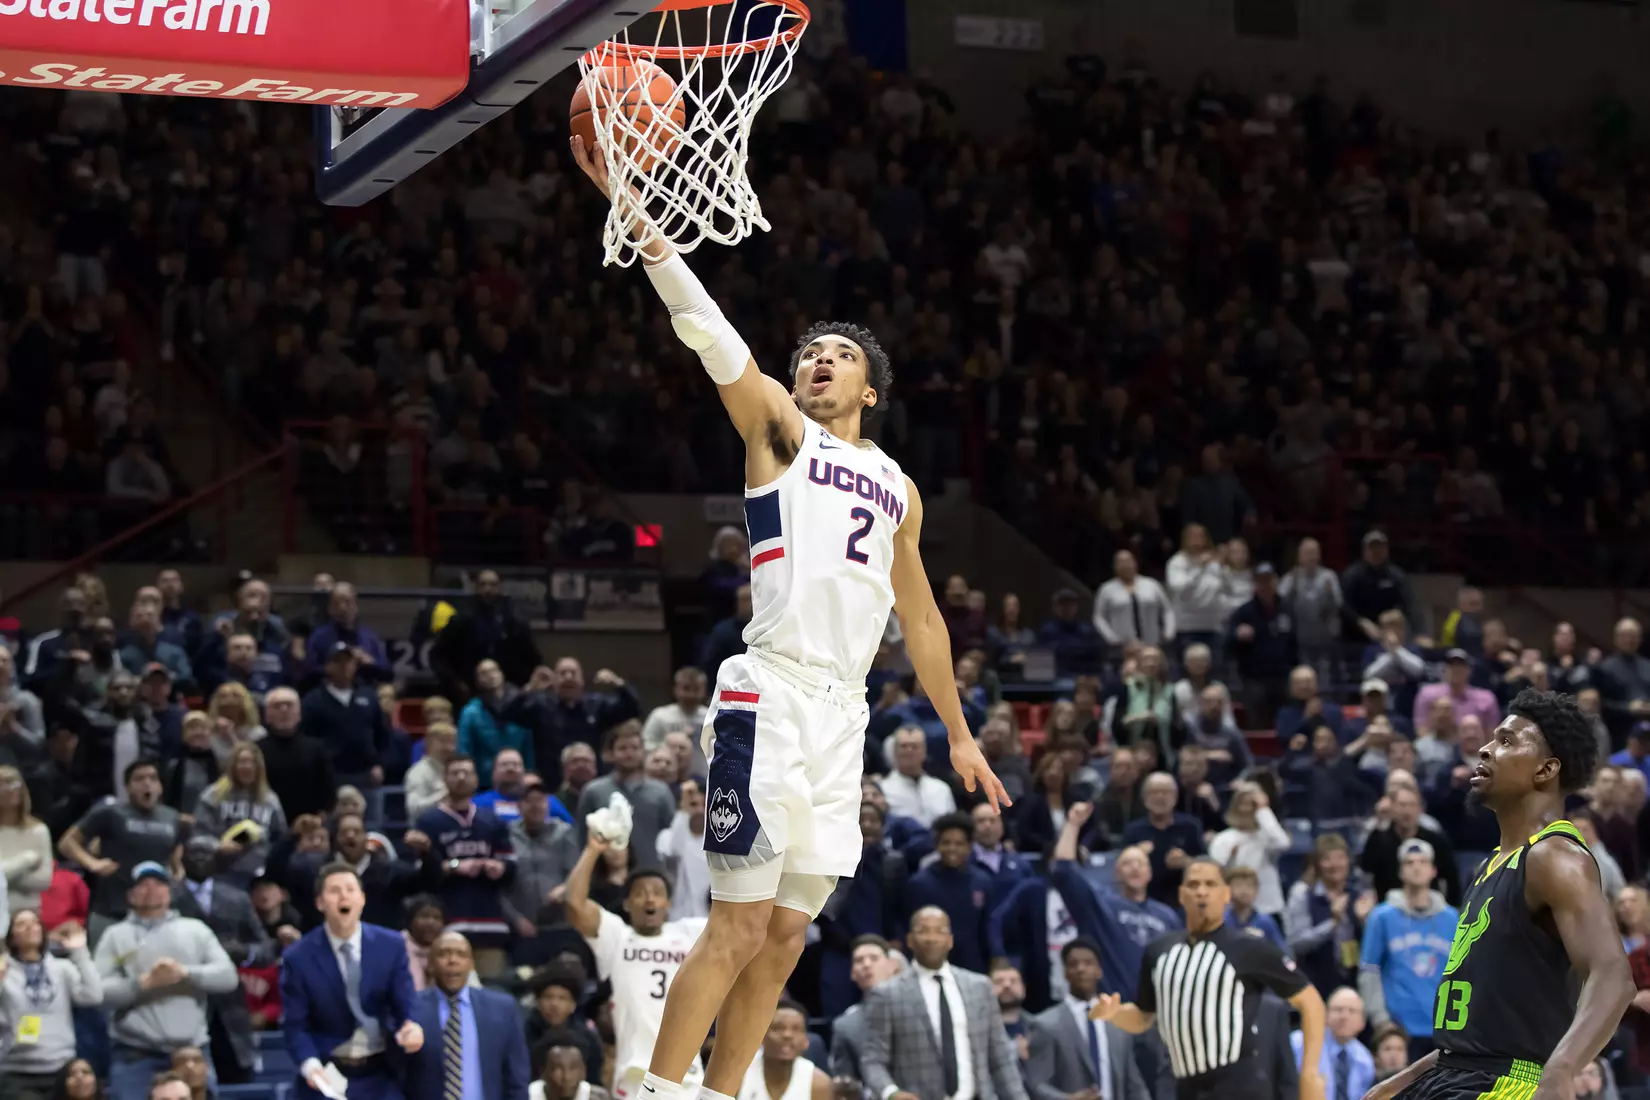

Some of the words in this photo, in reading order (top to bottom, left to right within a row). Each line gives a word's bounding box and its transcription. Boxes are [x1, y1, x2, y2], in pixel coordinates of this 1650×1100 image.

[808, 457, 904, 526] UCONN
[845, 506, 875, 565] 2
[650, 969, 666, 999] 3
[1434, 980, 1472, 1030] 13
